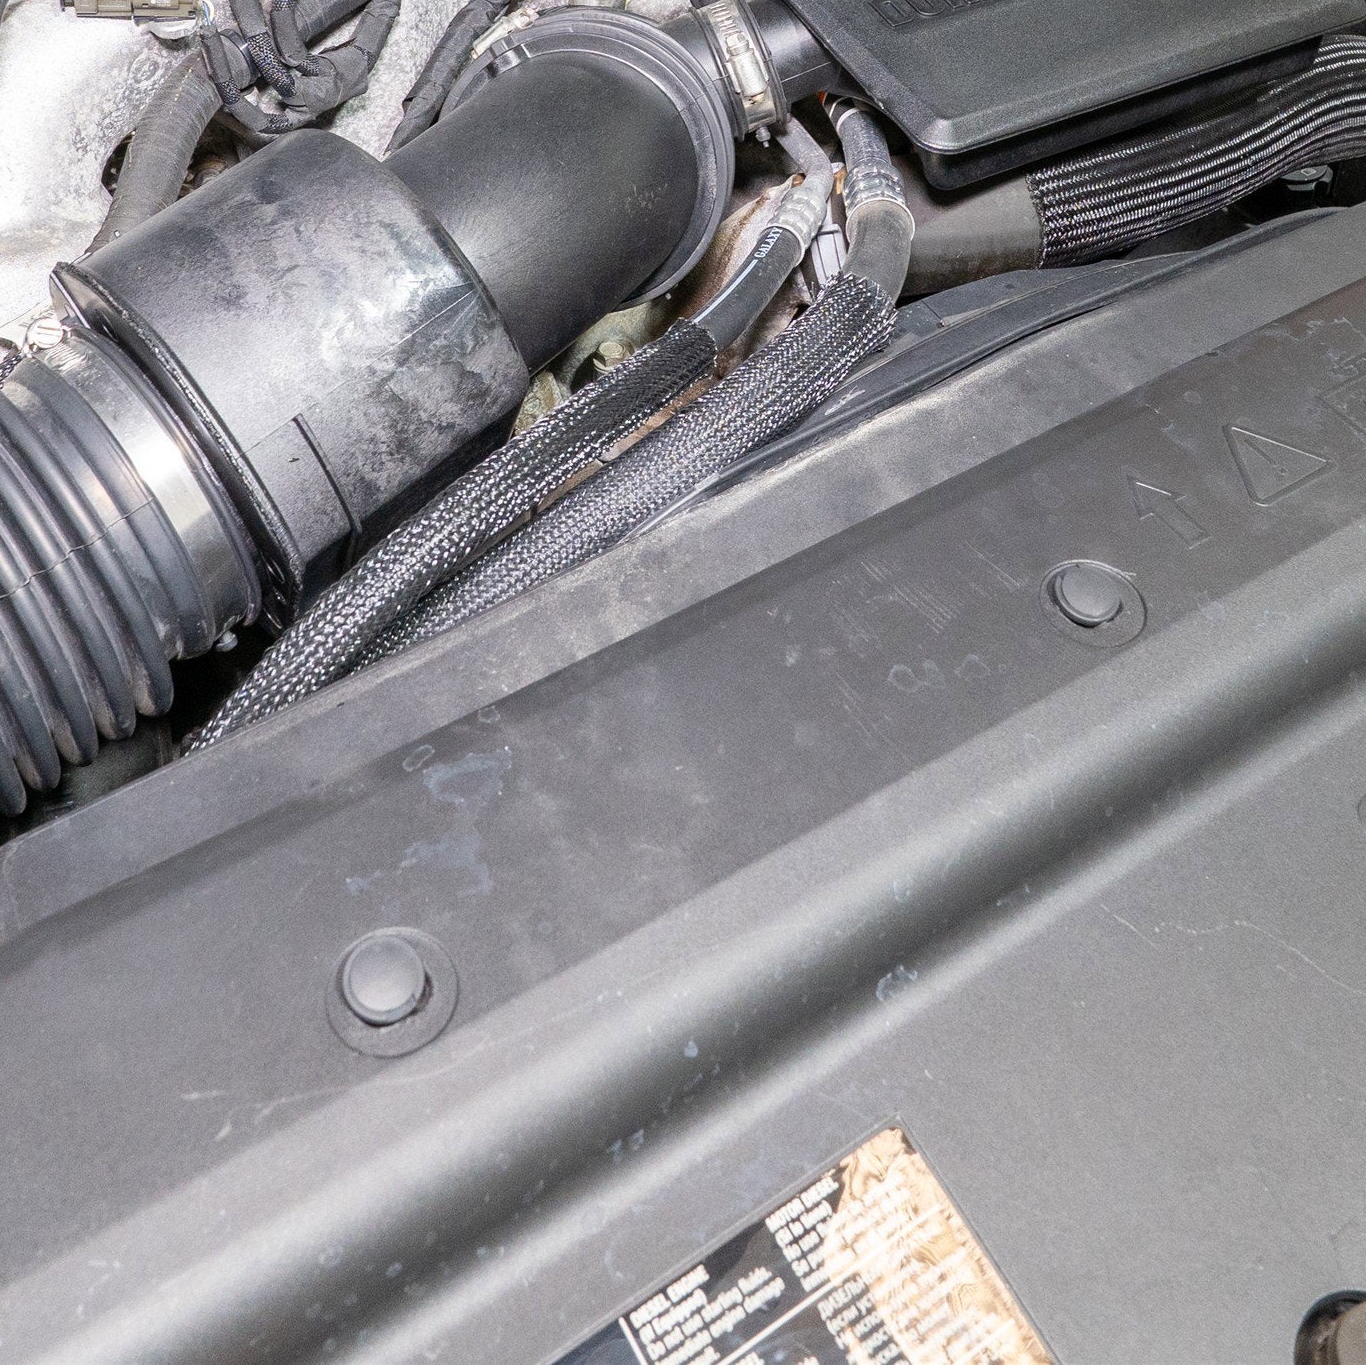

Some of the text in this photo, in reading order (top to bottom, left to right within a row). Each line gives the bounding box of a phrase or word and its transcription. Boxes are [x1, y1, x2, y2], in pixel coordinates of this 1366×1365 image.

[754, 227, 783, 258] GALAXY
[764, 1197, 806, 1234] MOTOR
[799, 1174, 840, 1208] DIESEL
[627, 1263, 711, 1330] DIESEL ENGINE
[645, 1338, 669, 1361] Do
[662, 1325, 686, 1349] not
[680, 1312, 705, 1336] use
[698, 1284, 744, 1324] starting
[706, 1303, 749, 1341] engine
[740, 1274, 789, 1316] damage
